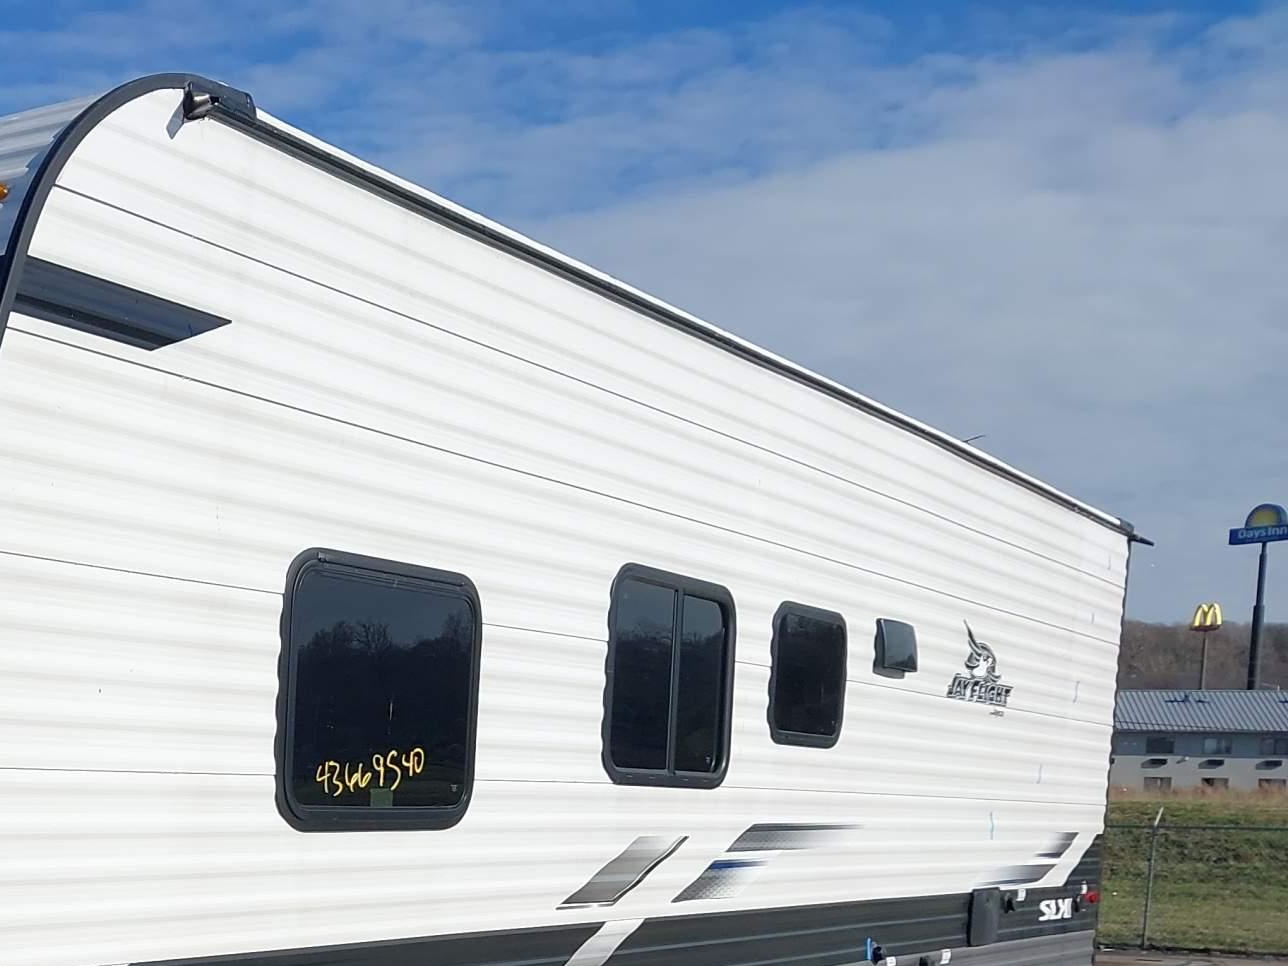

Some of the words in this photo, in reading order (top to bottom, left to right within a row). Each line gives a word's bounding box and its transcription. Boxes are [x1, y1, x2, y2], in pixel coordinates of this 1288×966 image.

[1238, 529, 1267, 540] Days
[947, 673, 971, 700] JAY
[968, 680, 1014, 707] FLIGHT
[316, 748, 424, 796] 43669540
